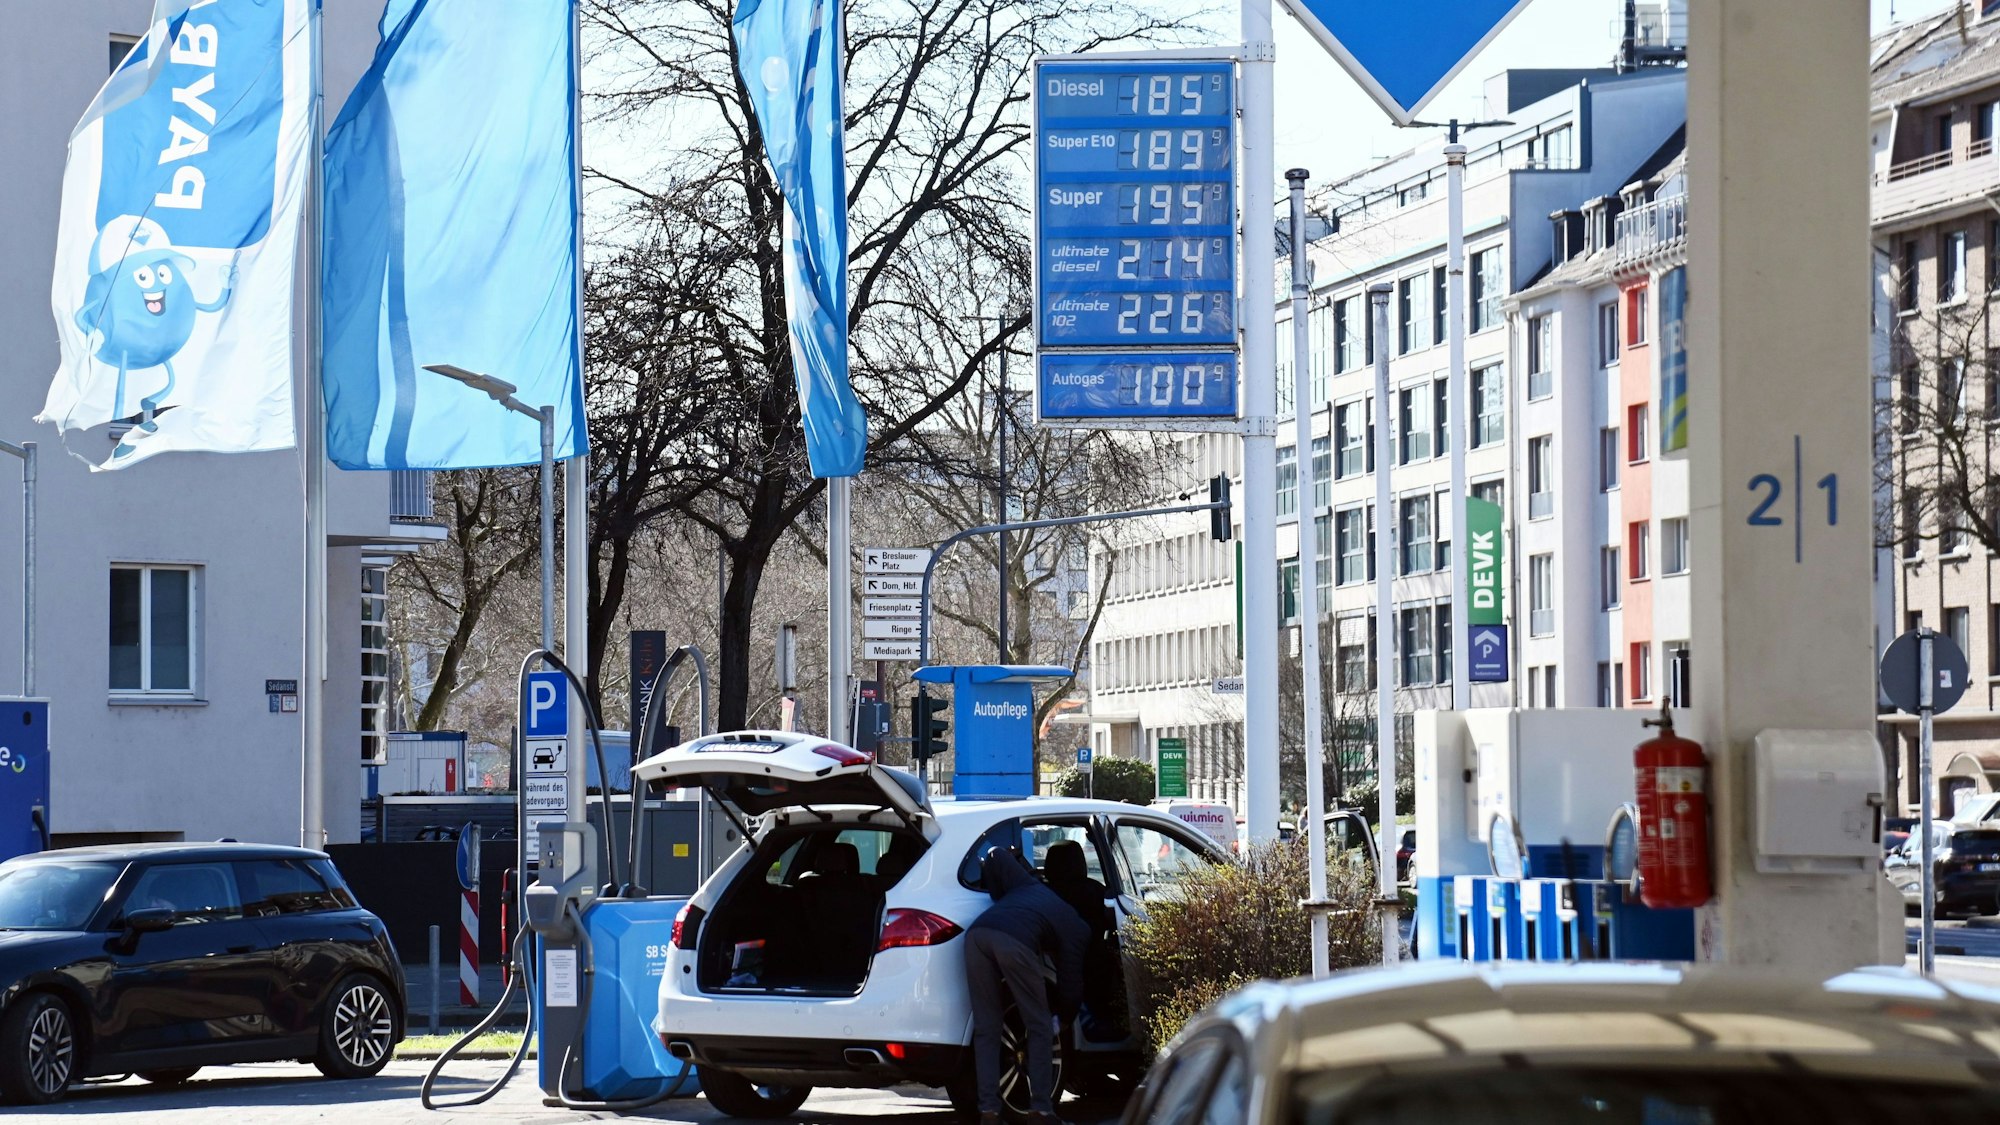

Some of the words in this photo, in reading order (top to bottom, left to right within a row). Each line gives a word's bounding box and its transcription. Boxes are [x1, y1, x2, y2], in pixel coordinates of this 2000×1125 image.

[1048, 79, 1104, 96] Diesel
[1131, 75, 1203, 115] 185
[1212, 75, 1222, 92] 9
[1048, 135, 1088, 150] Super
[1091, 135, 1115, 148] E10
[1131, 130, 1204, 170] 189
[1212, 130, 1222, 146] 9
[1049, 188, 1103, 208] Super
[1132, 185, 1204, 225] 195
[1213, 184, 1222, 201] 9
[1051, 245, 1110, 257] ultimate
[1118, 240, 1204, 279] 214
[1212, 238, 1222, 255] 9
[1051, 261, 1100, 272] diesel
[1051, 299, 1110, 311] ultimate
[1118, 294, 1204, 334] 226
[1052, 315, 1077, 327] 102
[1052, 373, 1104, 388] Autogas
[1134, 365, 1205, 406] 100
[1213, 365, 1223, 382] 9
[1747, 473, 1782, 526] 2
[1817, 473, 1837, 526] 1
[882, 552, 918, 560] Breslauer-
[882, 562, 900, 570] Platz
[1472, 530, 1495, 609] DEVK
[882, 582, 900, 591] Dom,
[903, 582, 917, 590] Hbf.
[869, 603, 912, 613] Friesenplatz
[891, 625, 912, 635] Ringe
[873, 646, 912, 657] Mediapark
[1482, 644, 1493, 659] P
[1217, 681, 1244, 691] Sedan
[530, 680, 557, 729] P
[974, 701, 1028, 719] Autopflege
[1080, 749, 1089, 761] P
[1162, 752, 1183, 760] DEVK
[552, 782, 563, 792] des
[526, 796, 565, 807] adevorgangs
[645, 945, 659, 958] SB
